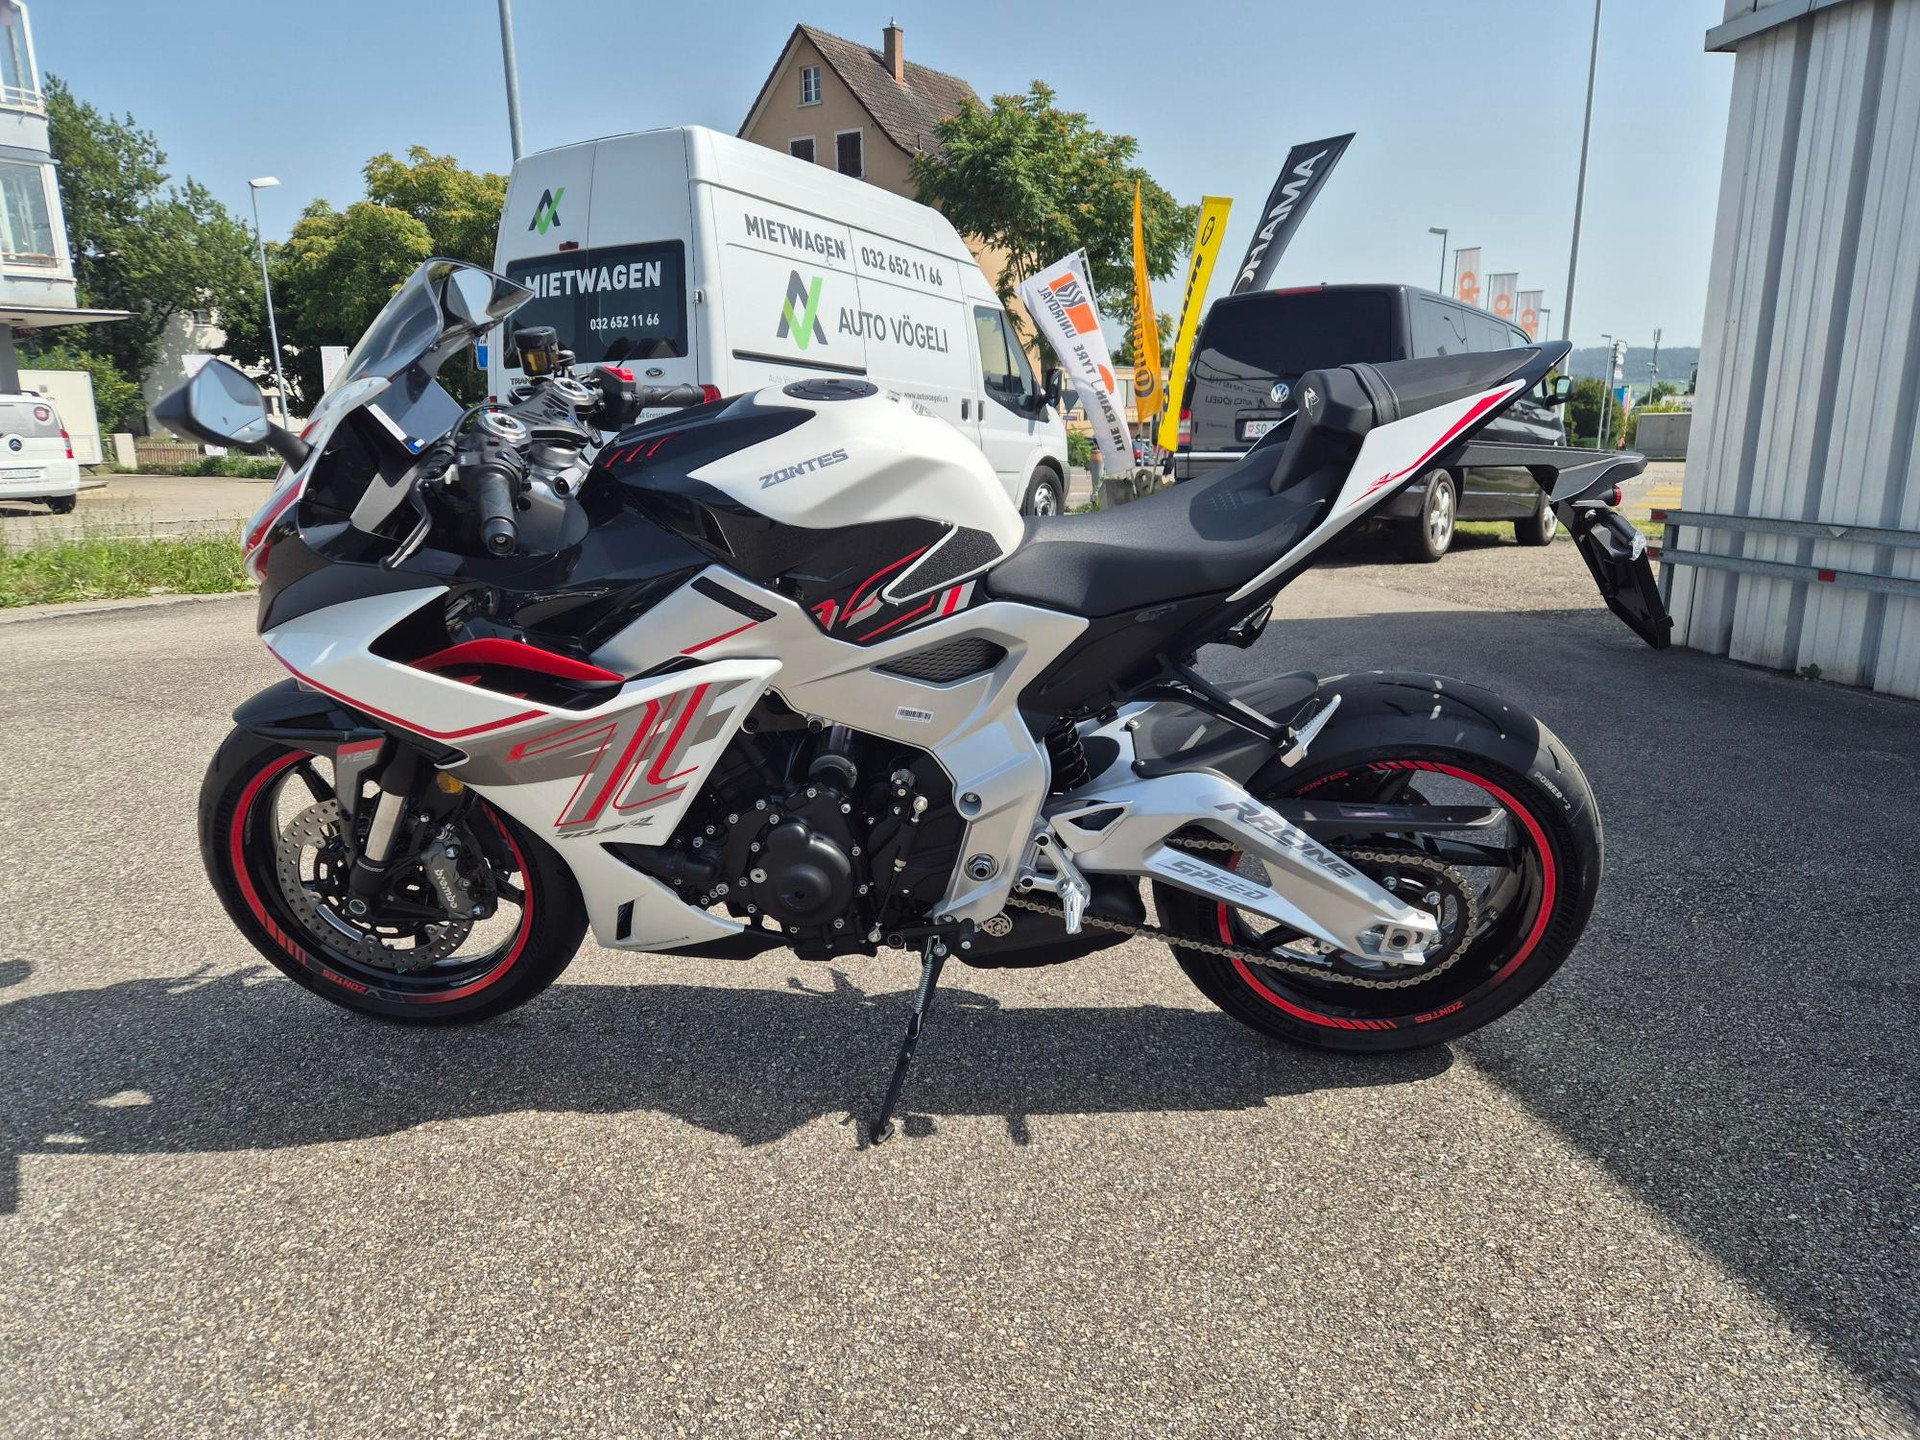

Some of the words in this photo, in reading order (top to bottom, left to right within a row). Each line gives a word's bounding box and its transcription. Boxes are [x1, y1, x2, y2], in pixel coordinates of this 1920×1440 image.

[744, 213, 847, 262] MIETWAGEN
[861, 246, 887, 272] 032
[889, 254, 912, 279] 652
[914, 261, 927, 282] 11
[929, 265, 943, 286] 66
[524, 260, 661, 299] MIETWAGEN
[590, 317, 609, 331] 032
[610, 316, 629, 329] 652
[631, 314, 643, 328] 11
[646, 313, 660, 327] 66
[839, 307, 887, 342] AUTO
[890, 314, 949, 354] VÖGELI
[759, 448, 849, 490] ZONTES
[342, 752, 373, 764] ABS
[1297, 771, 1348, 796] ZONTES
[1534, 771, 1563, 799] POWER
[1214, 801, 1356, 879] RACING
[434, 868, 458, 909] brembo
[1167, 860, 1270, 900] SPEED
[322, 969, 368, 993] ZONTES
[1414, 1000, 1464, 1024] ZONTES
